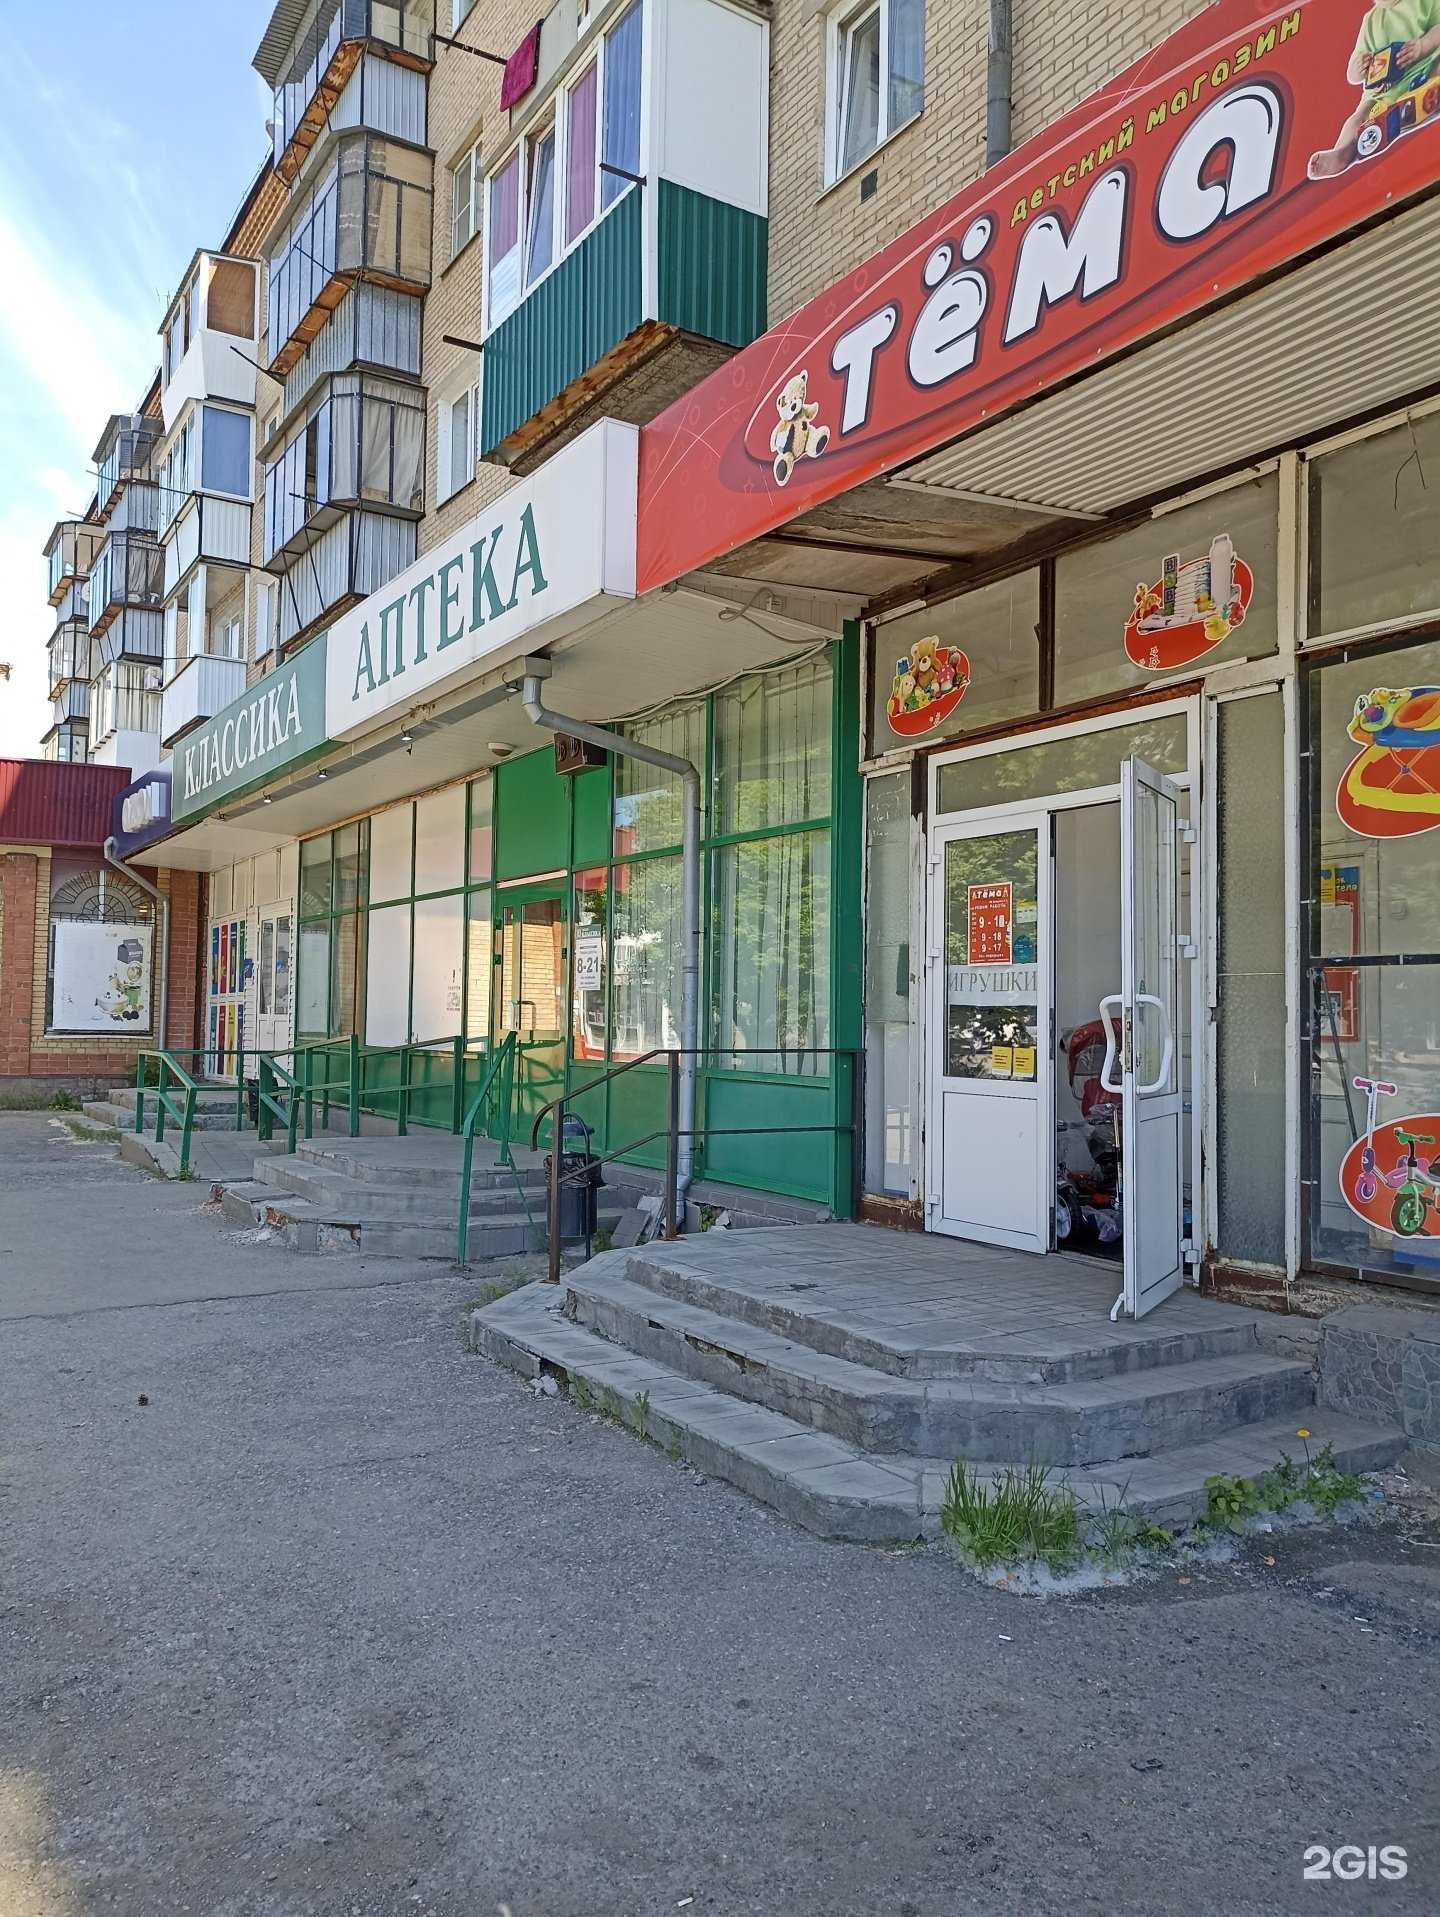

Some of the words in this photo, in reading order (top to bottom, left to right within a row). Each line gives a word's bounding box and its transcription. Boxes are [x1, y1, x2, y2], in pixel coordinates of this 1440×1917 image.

[1011, 115, 1136, 227] детский
[1144, 9, 1302, 135] магазин
[351, 501, 549, 702] АПТЕКА
[183, 671, 303, 800] КЛАССИКА
[979, 916, 985, 928] 9
[577, 956, 599, 974] 8-21
[949, 971, 1038, 992] ИГРУШКИ
